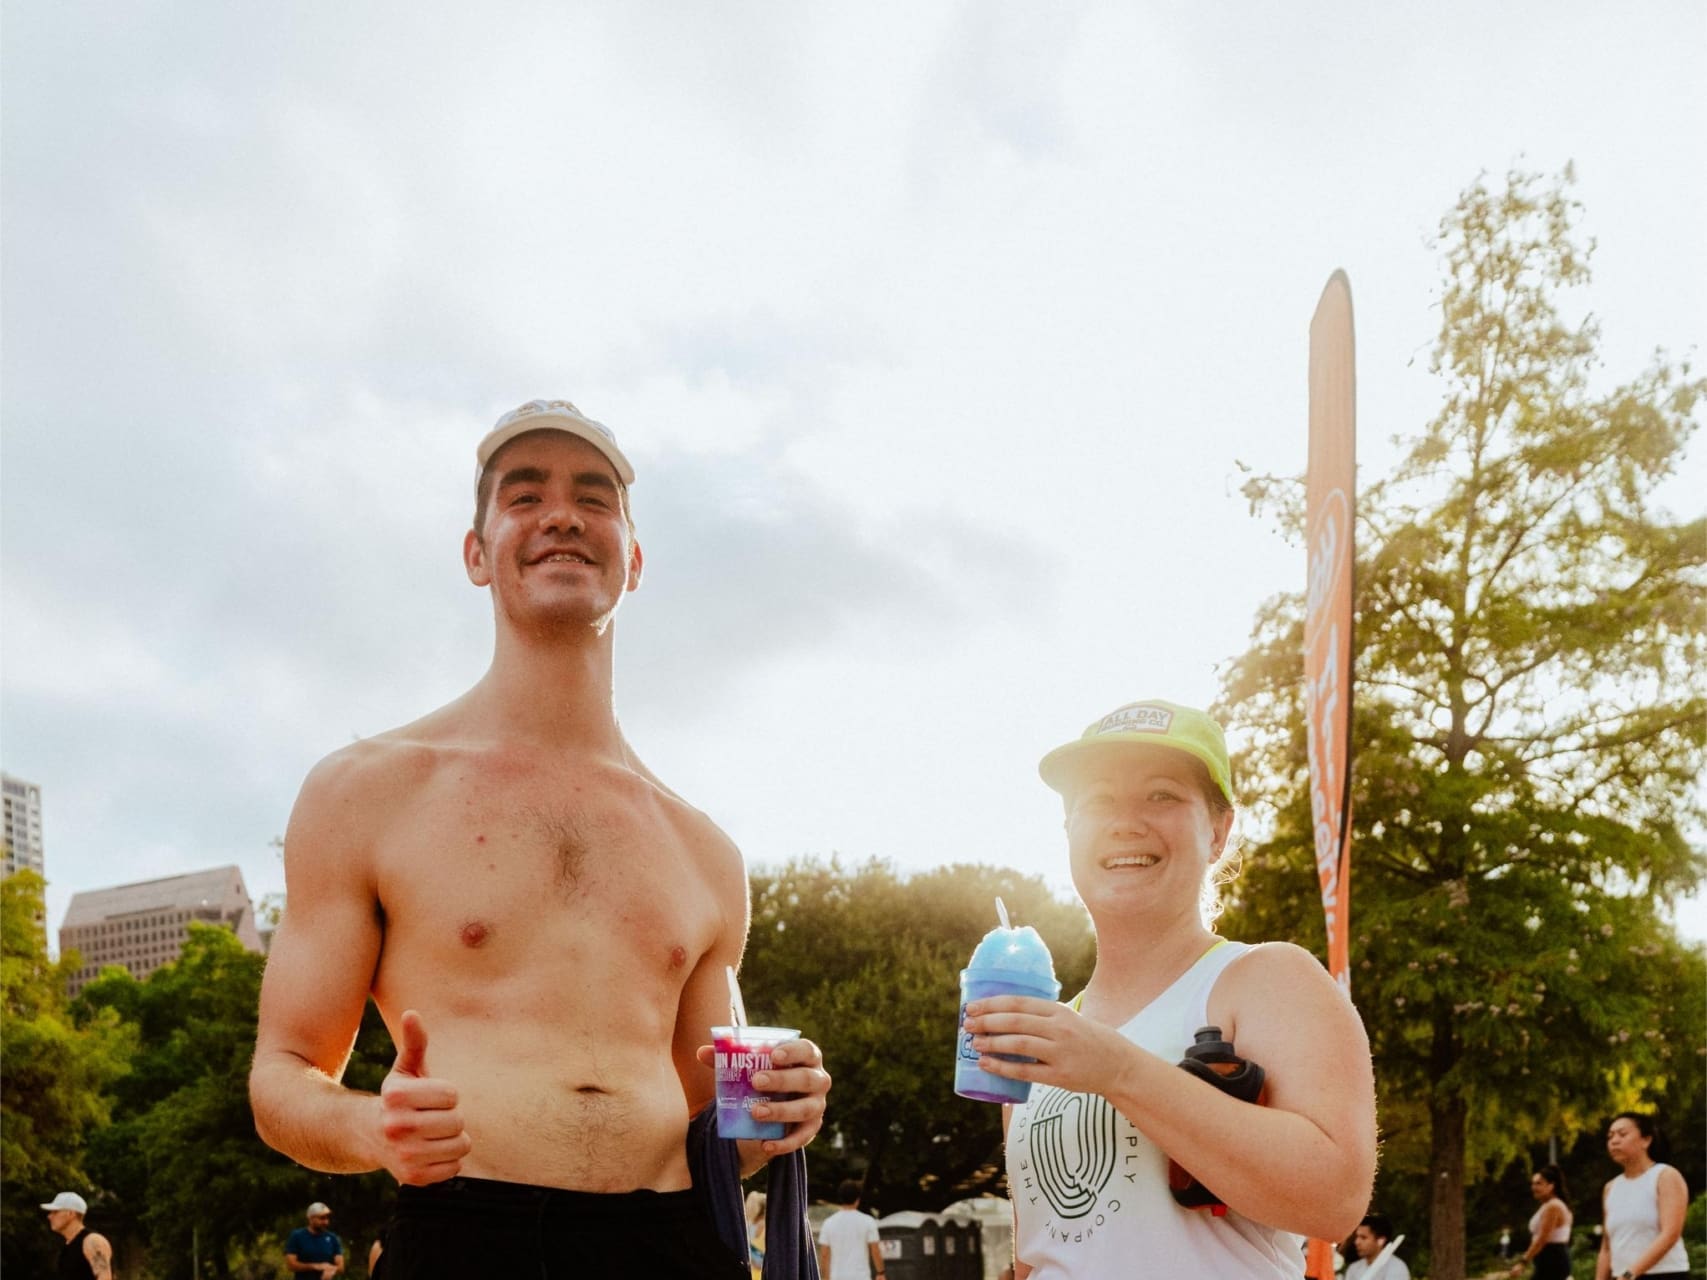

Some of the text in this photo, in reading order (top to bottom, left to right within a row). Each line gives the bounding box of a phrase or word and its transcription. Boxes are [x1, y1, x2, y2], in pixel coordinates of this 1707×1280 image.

[1136, 710, 1168, 722] DAY
[1019, 1159, 1039, 1206] THE
[1124, 1117, 1138, 1184] PLY
